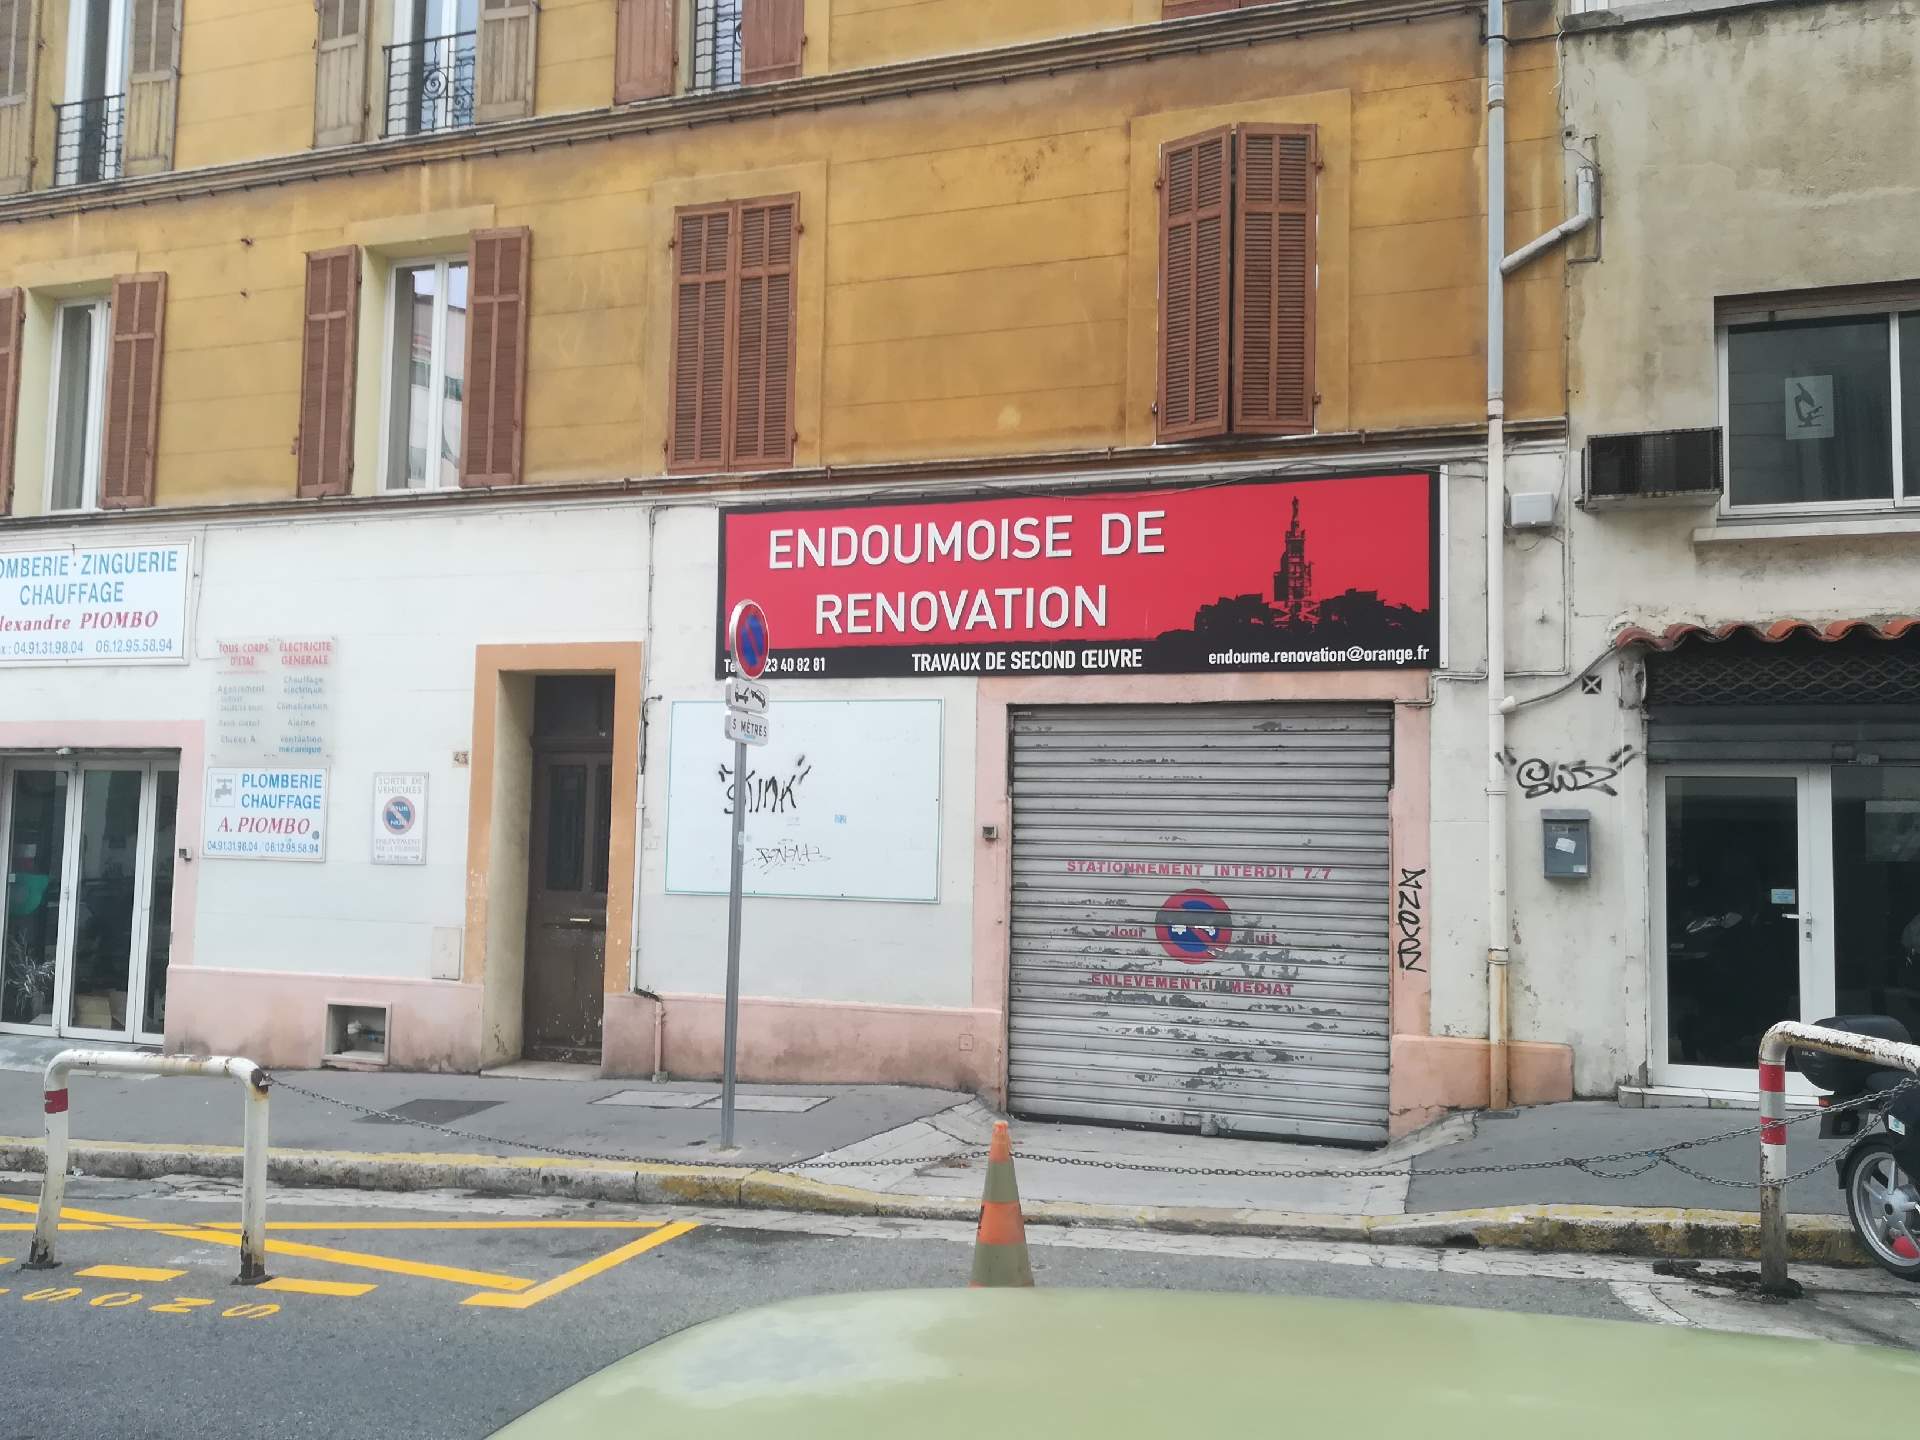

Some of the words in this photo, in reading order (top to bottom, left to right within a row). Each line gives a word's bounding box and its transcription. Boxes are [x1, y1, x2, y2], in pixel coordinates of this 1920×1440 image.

[769, 515, 1073, 569] ENDOUMOISE
[1100, 510, 1166, 556] DE
[81, 551, 178, 575] ZINGUERIE
[20, 582, 125, 606] CHAUFFAGE
[815, 584, 1108, 635] RENOVATION
[80, 611, 159, 630] PIOMBO
[765, 658, 778, 672] 23
[781, 658, 794, 671] 40
[797, 657, 810, 671] 82
[813, 657, 826, 671] 81
[912, 651, 981, 673] TRAVAUX
[985, 651, 1006, 670] DE
[1010, 649, 1076, 670] SECOND
[1081, 648, 1142, 669] ŒUVRE
[1208, 645, 1430, 665] endoume.renovation@orange.fr
[241, 774, 323, 789] PLOMBERIE
[241, 793, 321, 809] CHAUFFAGE
[217, 816, 233, 833] A.
[237, 816, 311, 835] PIOMBO
[1067, 861, 1204, 876] STATIONNEMENT
[1213, 864, 1295, 879] INTERDIT
[1091, 972, 1201, 989] ENLEVEMENT
